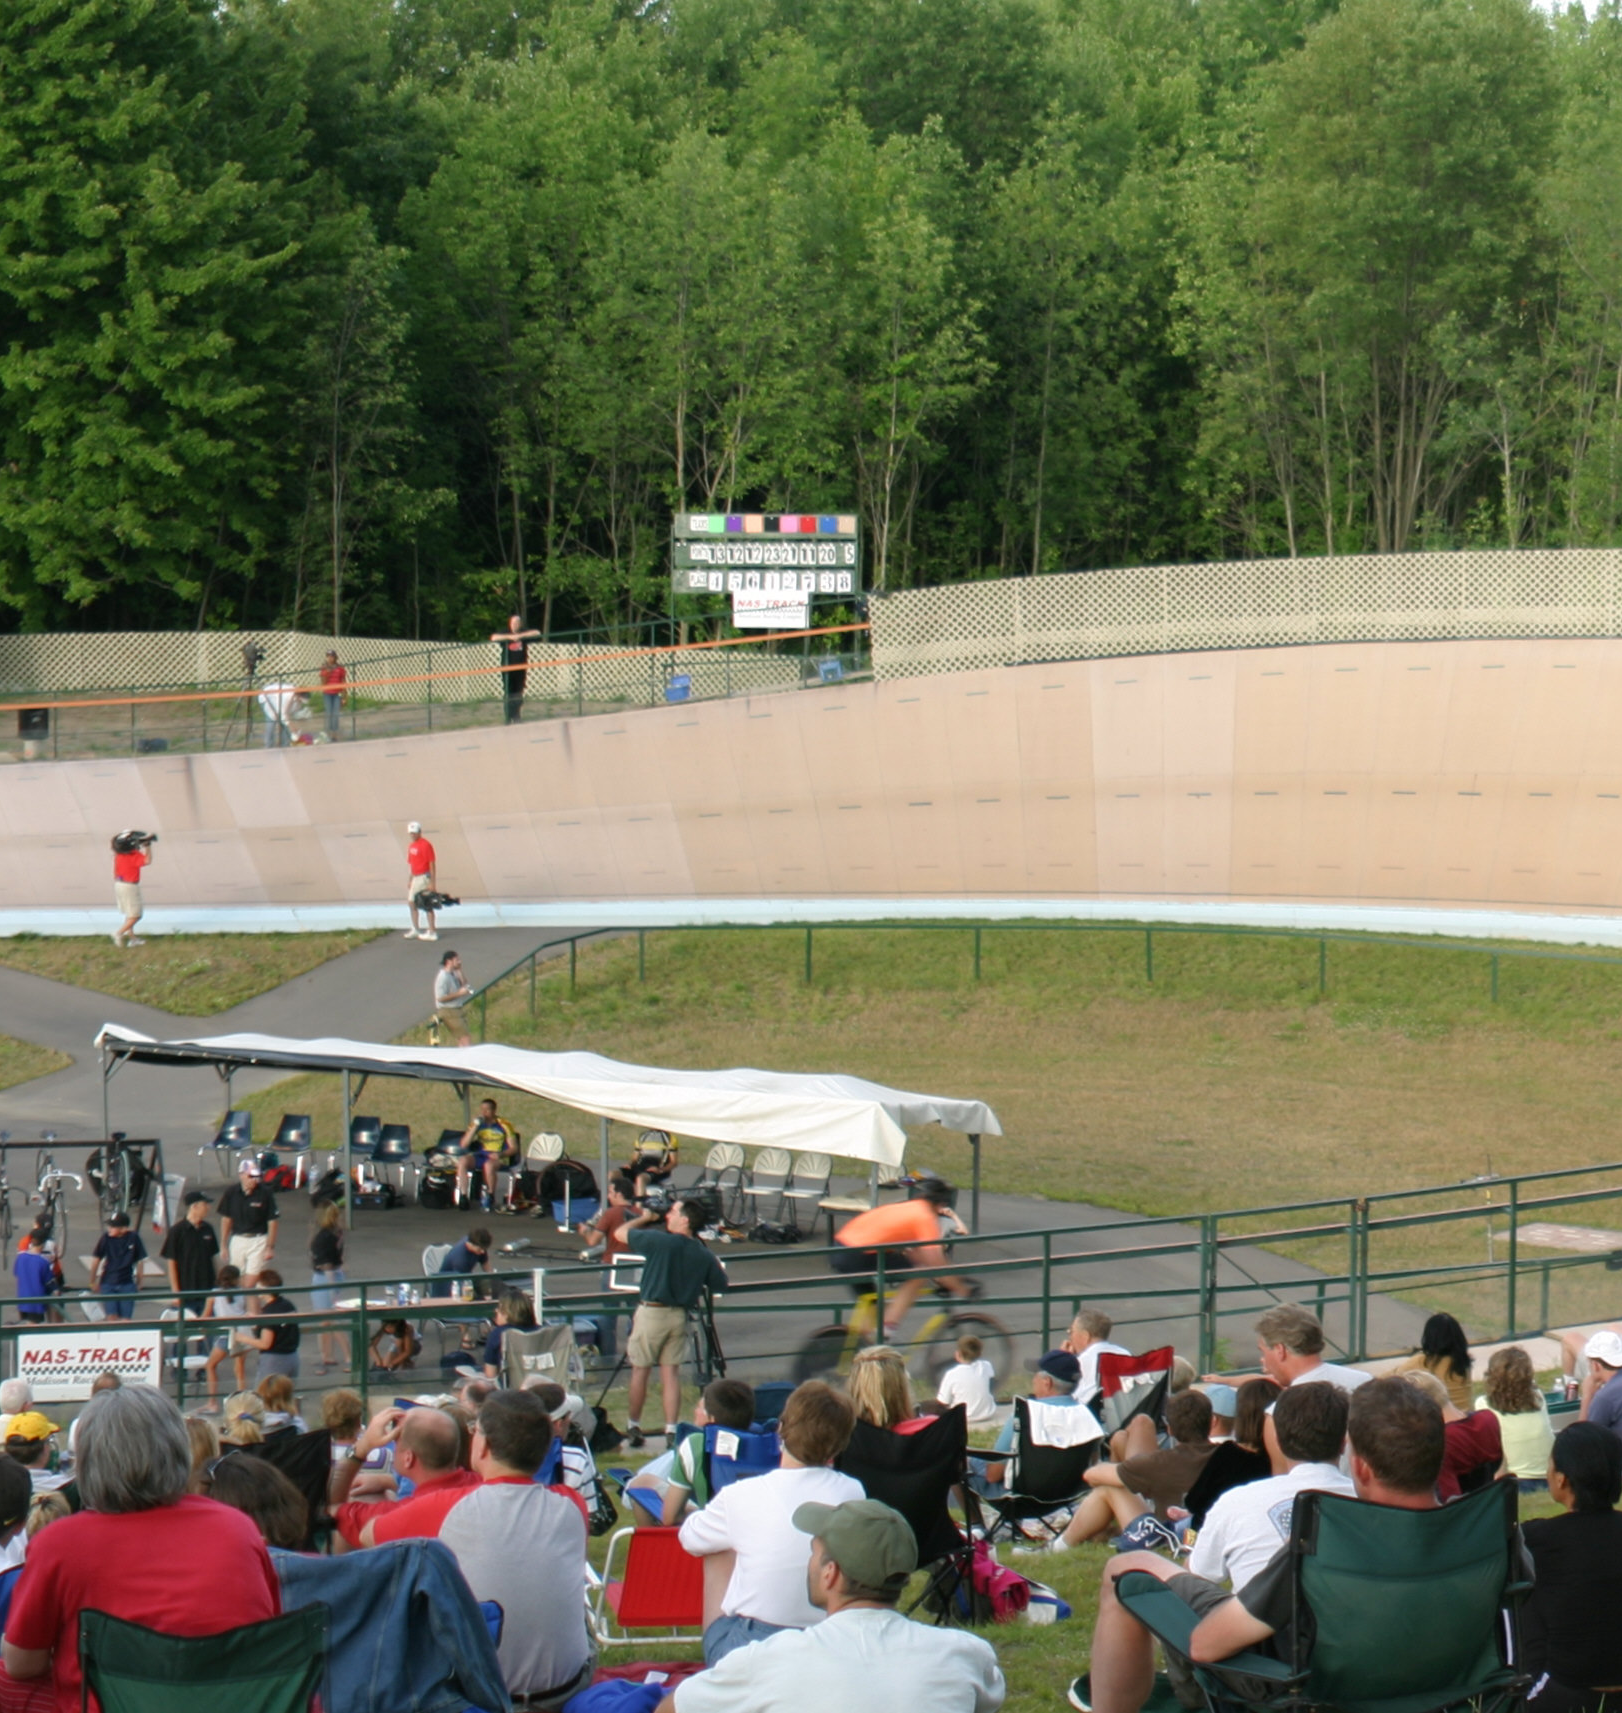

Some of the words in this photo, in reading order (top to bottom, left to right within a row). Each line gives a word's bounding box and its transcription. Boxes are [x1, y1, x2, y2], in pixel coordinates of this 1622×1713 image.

[709, 548, 725, 561] 13
[729, 548, 743, 561] 12
[747, 548, 761, 561] 12
[766, 548, 780, 561] 23
[783, 548, 796, 561] 21
[802, 548, 815, 561] 11
[820, 548, 835, 561] 20
[731, 575, 739, 589] 5
[748, 575, 757, 589] 6
[822, 575, 832, 589] 3
[840, 575, 848, 589] 8
[737, 600, 806, 608] NAS-TRACK
[22, 1347, 155, 1364] NAS-TRACK
